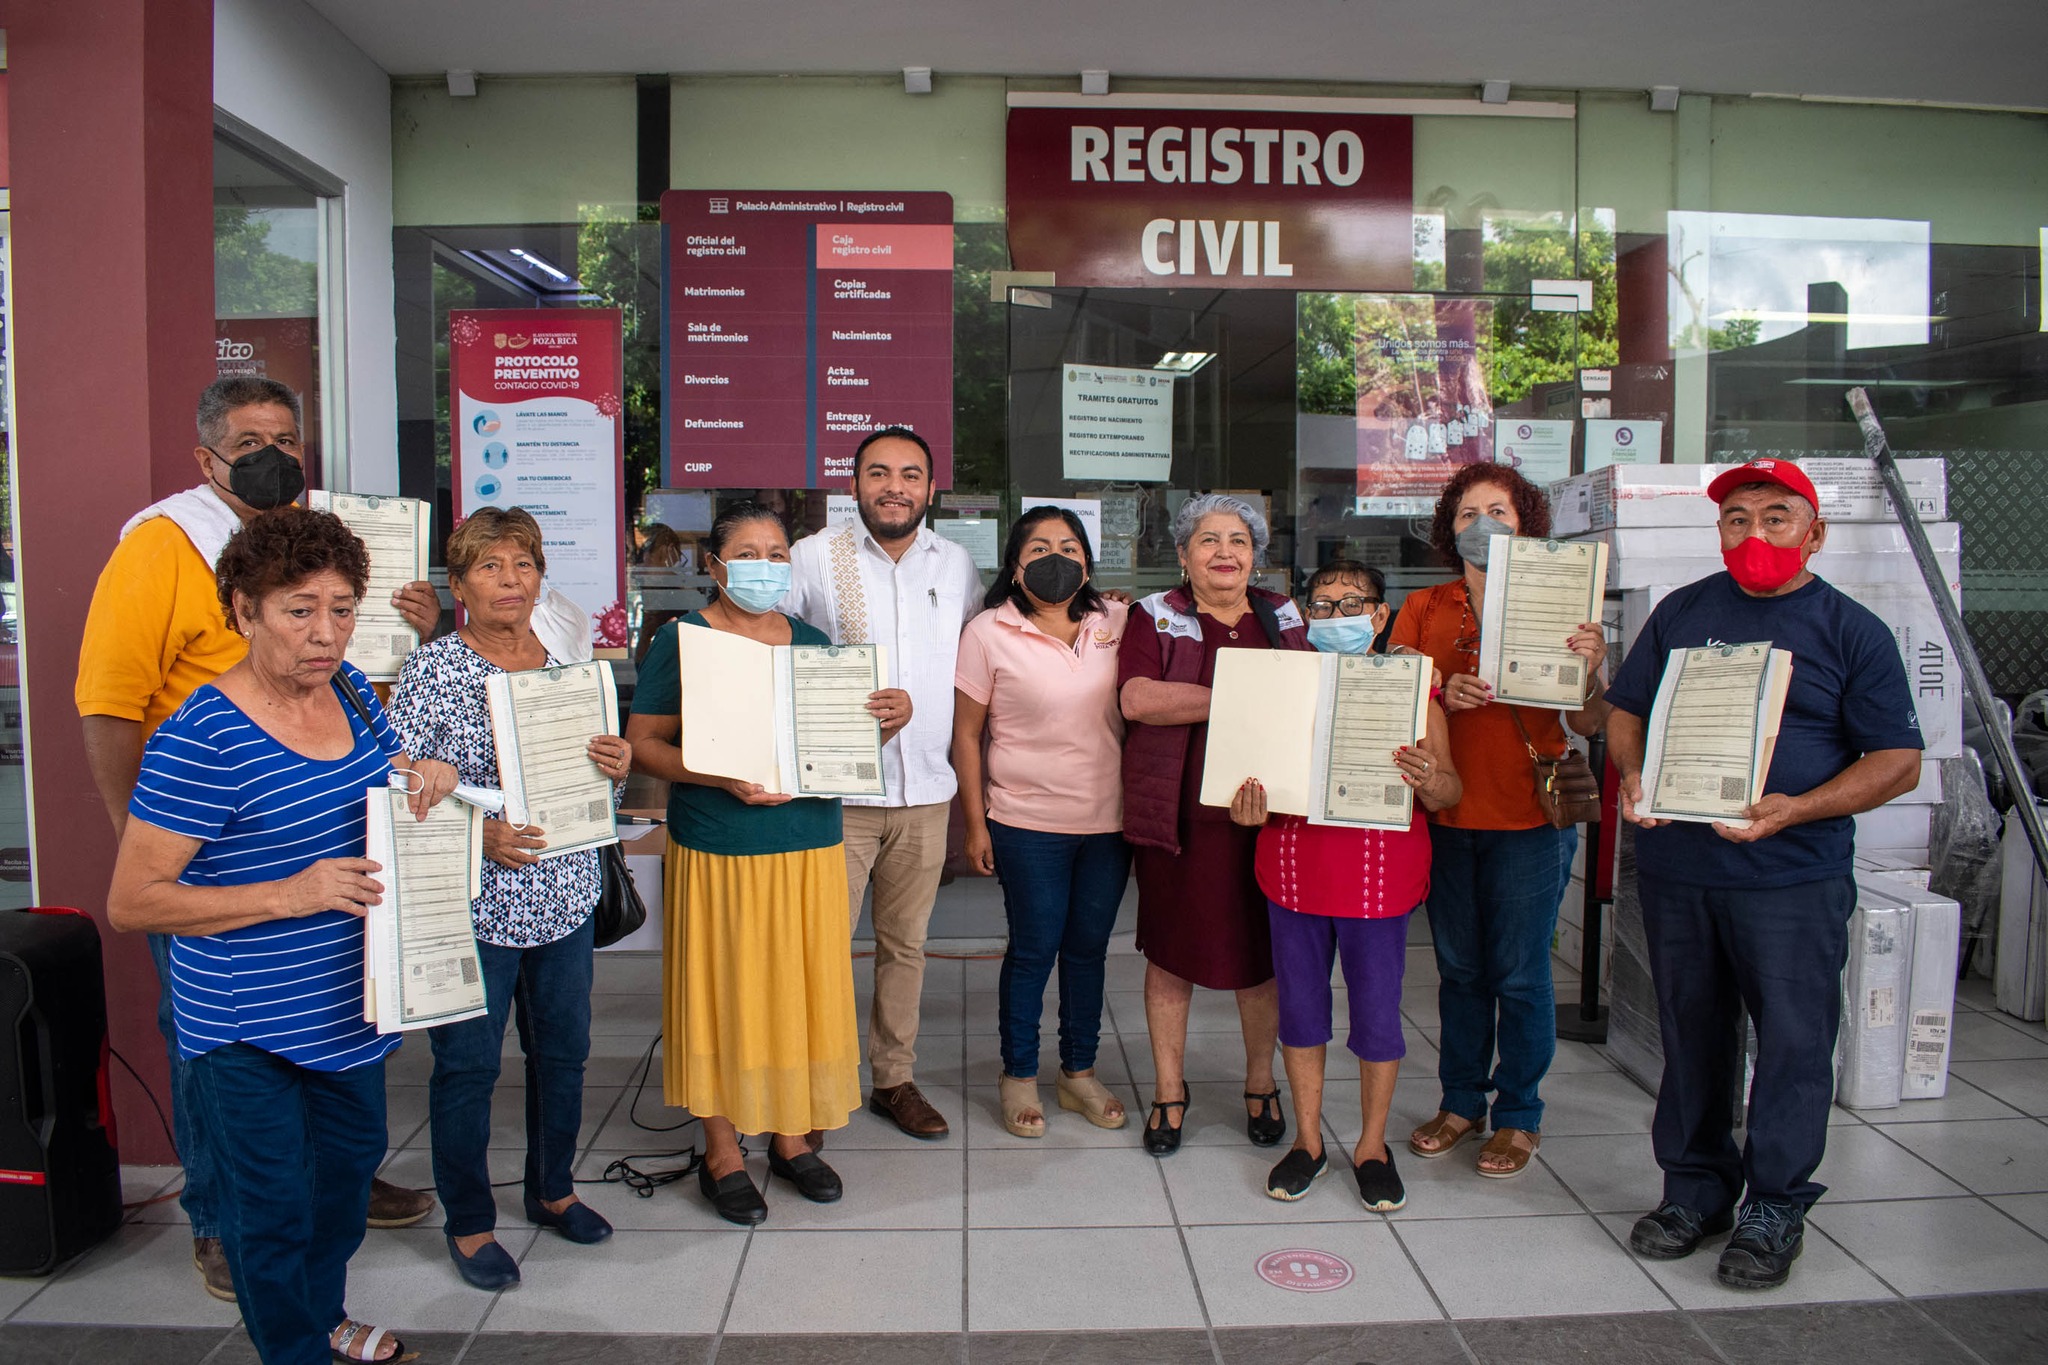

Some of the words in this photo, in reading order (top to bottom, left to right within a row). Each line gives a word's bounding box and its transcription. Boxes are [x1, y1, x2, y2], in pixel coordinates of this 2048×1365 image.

[1071, 125, 1365, 187] REGISTRO
[736, 201, 768, 212] Palacio
[769, 201, 837, 212] Administrativo
[847, 202, 884, 213] Registro
[885, 202, 904, 212] civil
[687, 235, 719, 246] Oficial
[720, 235, 735, 246] del
[832, 235, 853, 246] Caja
[687, 246, 725, 257] registro
[727, 246, 746, 256] civil
[832, 246, 870, 257] registro
[872, 245, 891, 255] civil
[1141, 218, 1293, 276] CIVIL
[834, 279, 866, 290] Copias
[684, 286, 745, 296] Matrimonios
[834, 289, 891, 299] certificadas
[688, 323, 708, 333] Sala
[710, 323, 721, 333] de
[688, 333, 749, 343] matrimonios
[832, 331, 892, 341] Nacimientos
[216, 338, 253, 360] tico
[1414, 340, 1447, 348] somos
[495, 356, 579, 367] PROTOCOLO
[494, 369, 580, 380] PREVENTIVO
[827, 366, 854, 376] Actas
[684, 375, 729, 385] Divorcios
[827, 375, 869, 386] foráneas
[494, 382, 539, 390] CONTAGIO
[540, 382, 580, 390] COVID-19
[1078, 394, 1115, 403] TRAMITES
[1117, 396, 1159, 406] GRATUITOS
[826, 412, 863, 423] Entrega
[865, 414, 871, 423] y
[684, 419, 744, 429] Defunciones
[826, 421, 872, 433] recepción
[874, 421, 886, 432] de
[1099, 433, 1144, 441] EXTEMPORANEO
[1121, 451, 1170, 459] ADMINISTRATIVAS
[824, 456, 855, 467] Rectifi
[684, 463, 713, 473] CURP
[824, 467, 854, 477] admin
